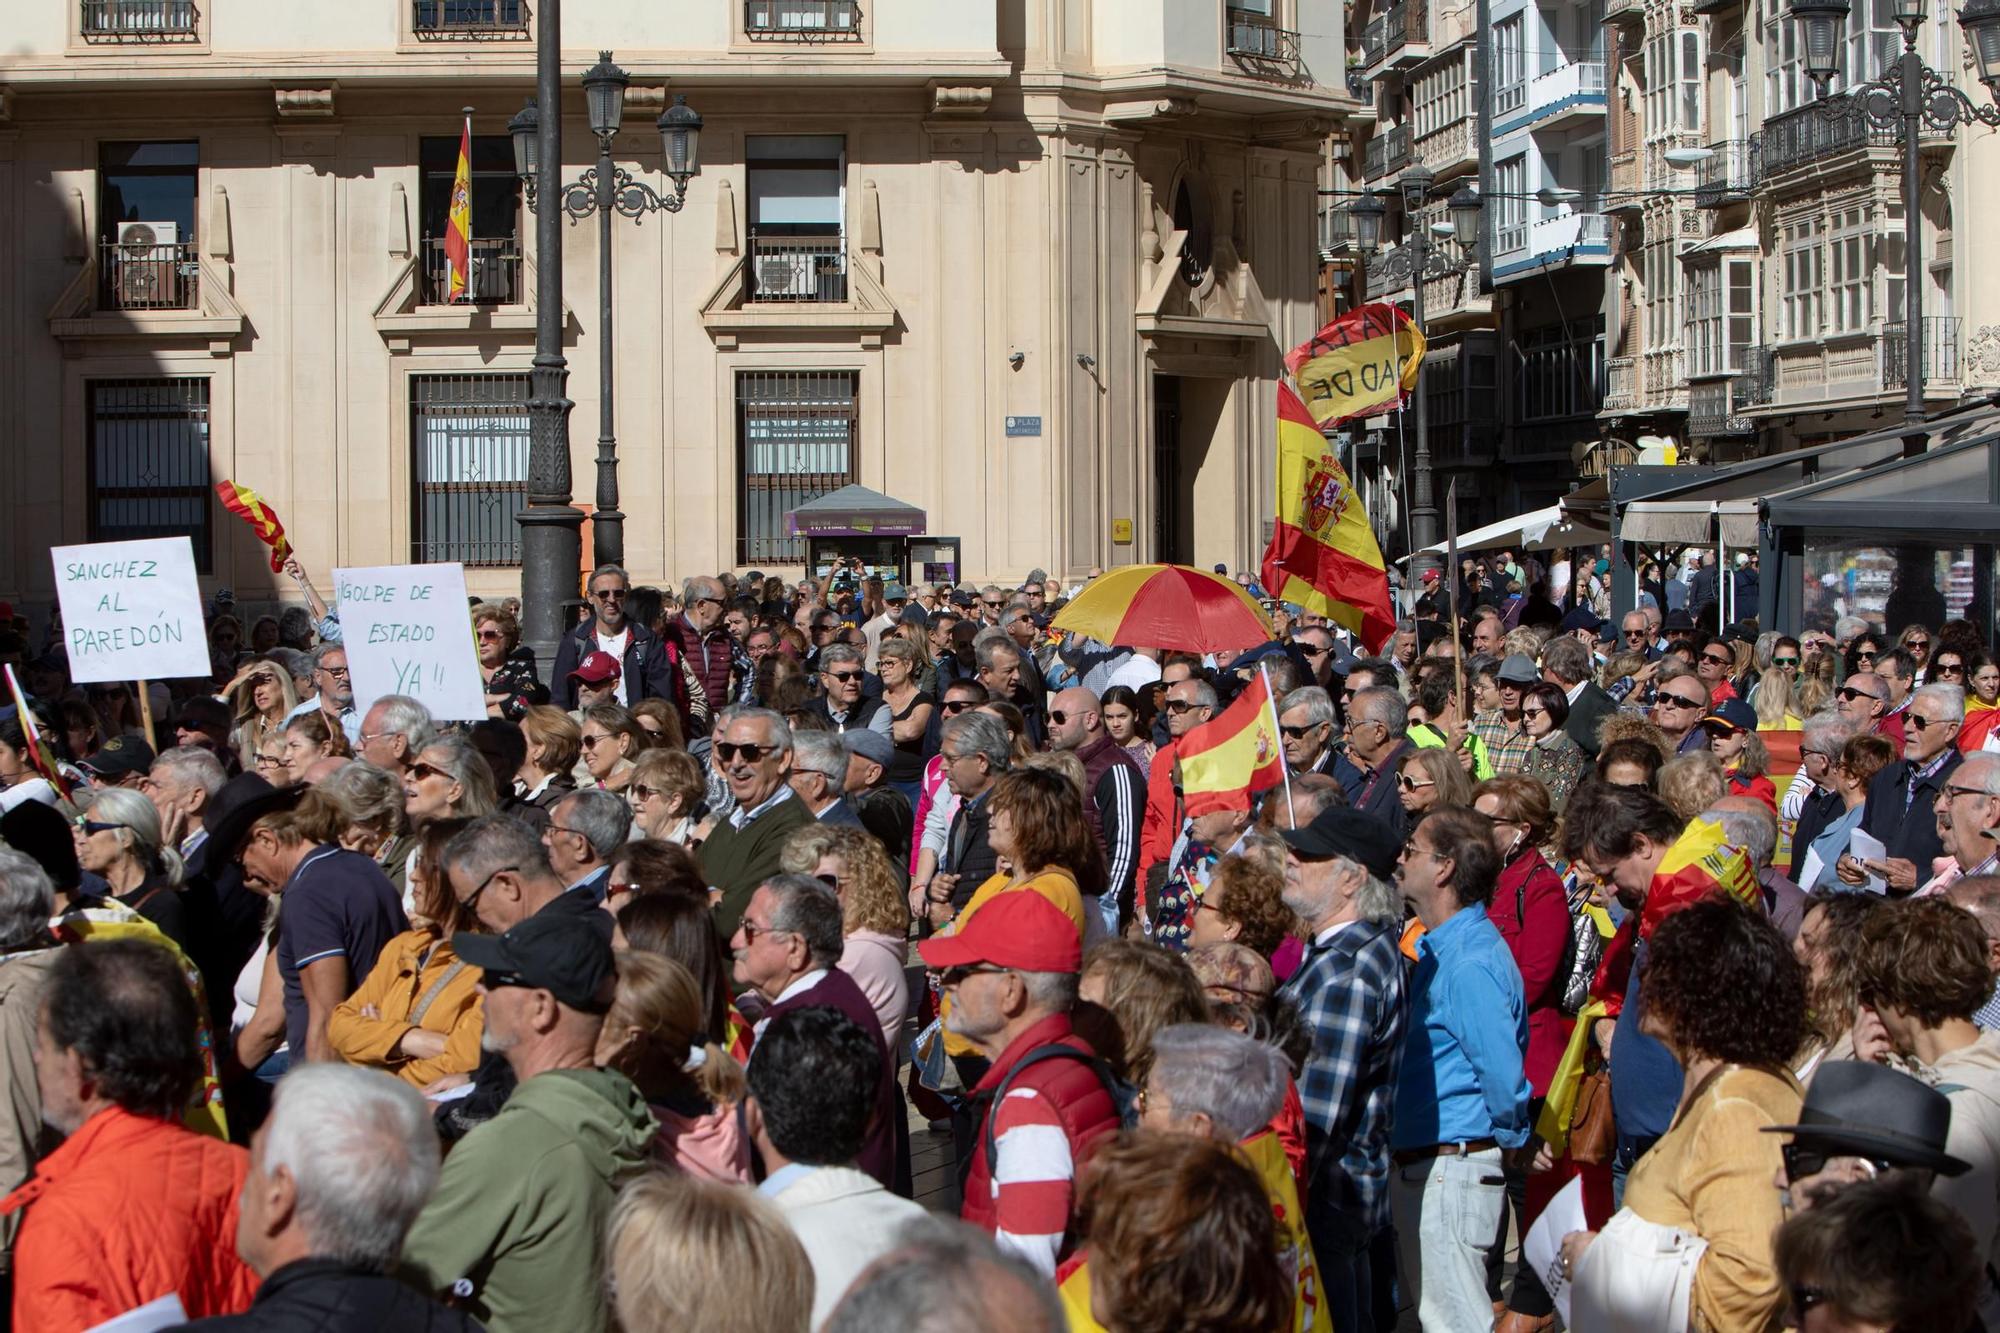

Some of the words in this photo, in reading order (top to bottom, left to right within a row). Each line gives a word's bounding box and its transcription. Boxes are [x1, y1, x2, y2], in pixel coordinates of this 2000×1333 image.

[1017, 418, 1040, 426] PLAZA
[66, 560, 158, 582] SANCHEZ
[97, 592, 129, 613] AL
[409, 585, 433, 601] DE
[72, 610, 183, 656] PAREDÓN
[368, 623, 435, 645] ESTADO
